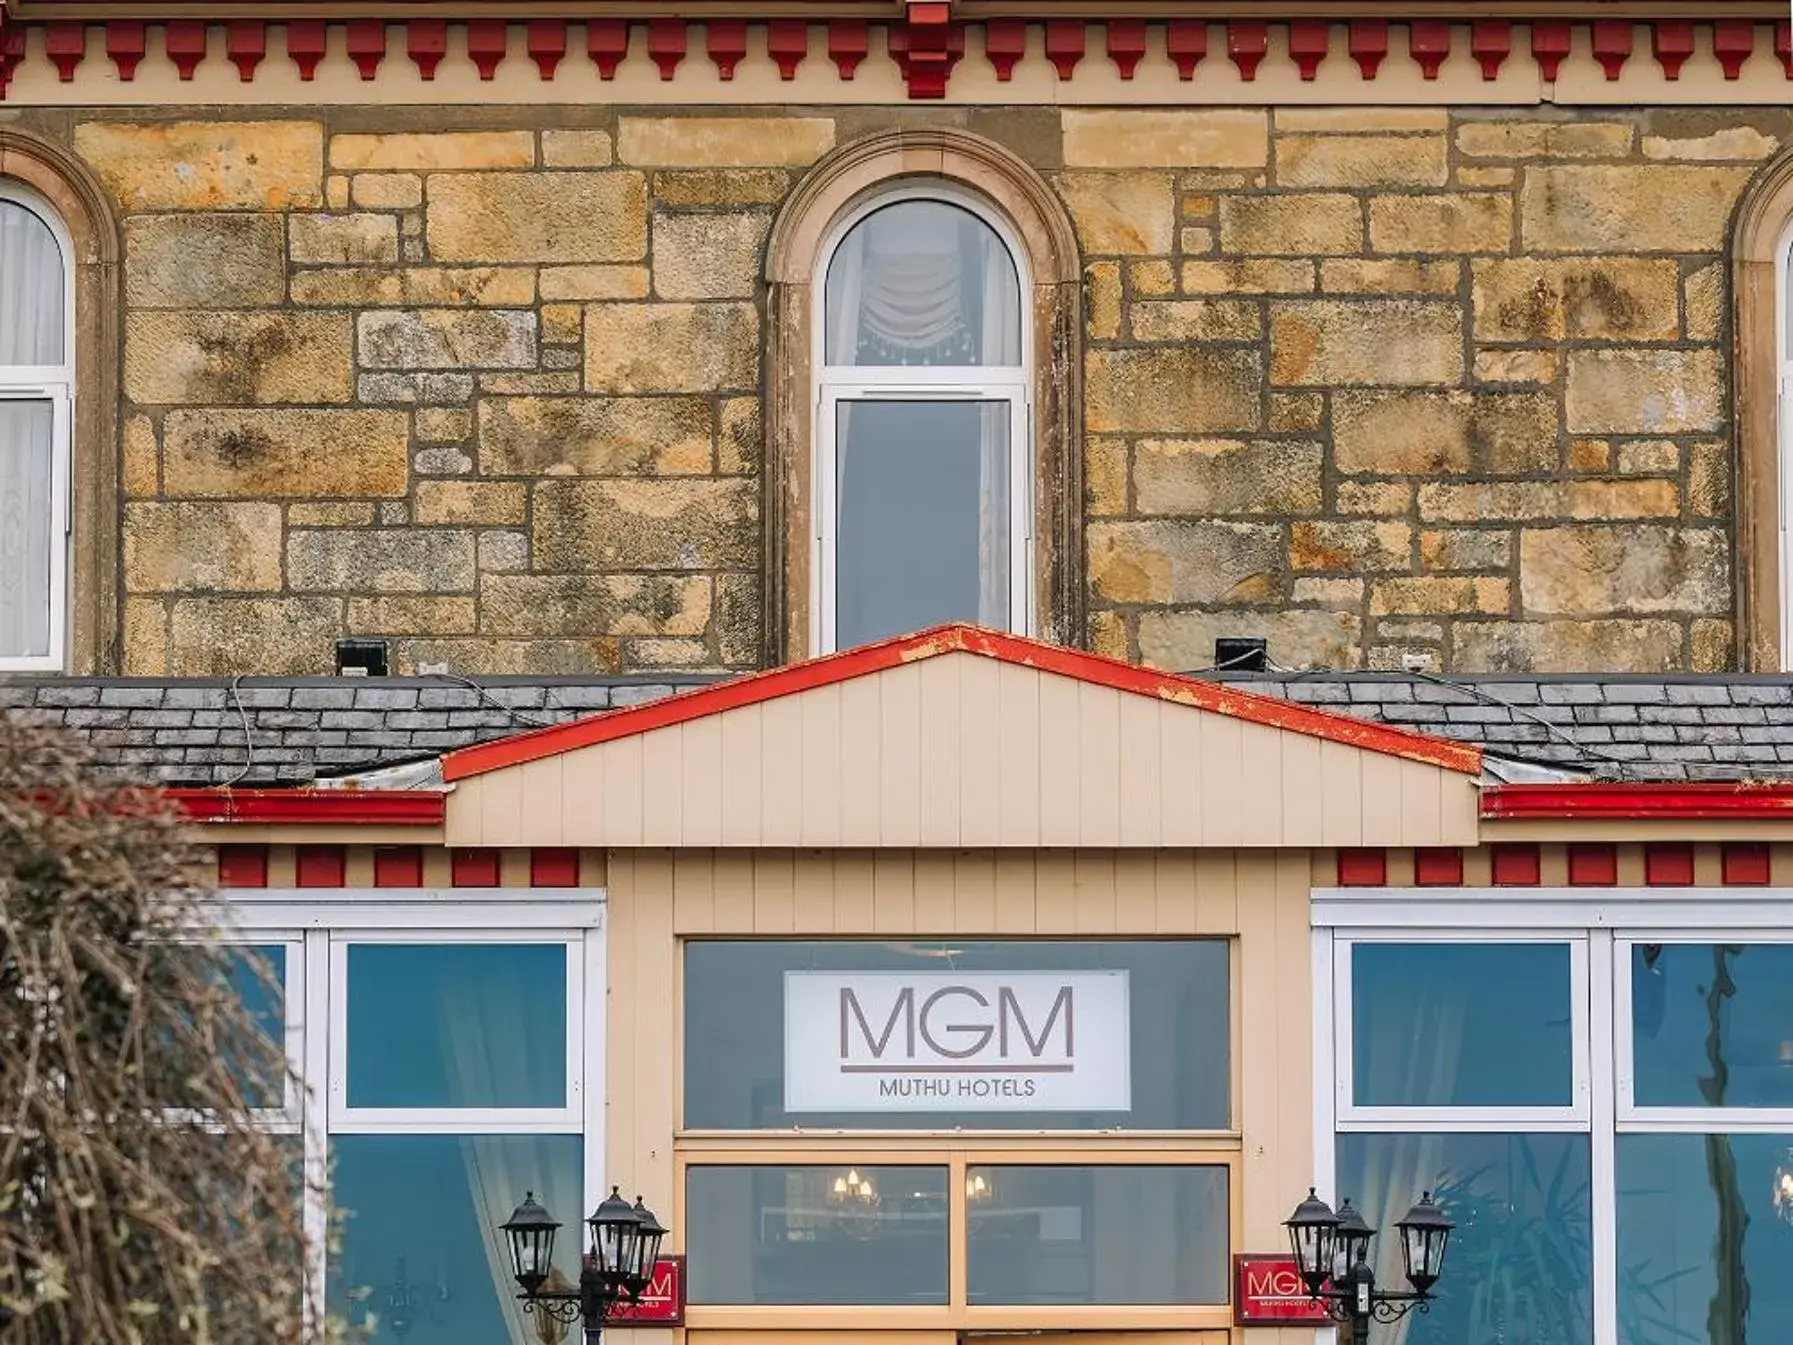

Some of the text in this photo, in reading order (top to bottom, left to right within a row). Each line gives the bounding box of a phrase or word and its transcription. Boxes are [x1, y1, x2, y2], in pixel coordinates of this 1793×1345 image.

[840, 985, 1074, 1059] MGM
[879, 1079, 1036, 1097] MUTHU HOTELS
